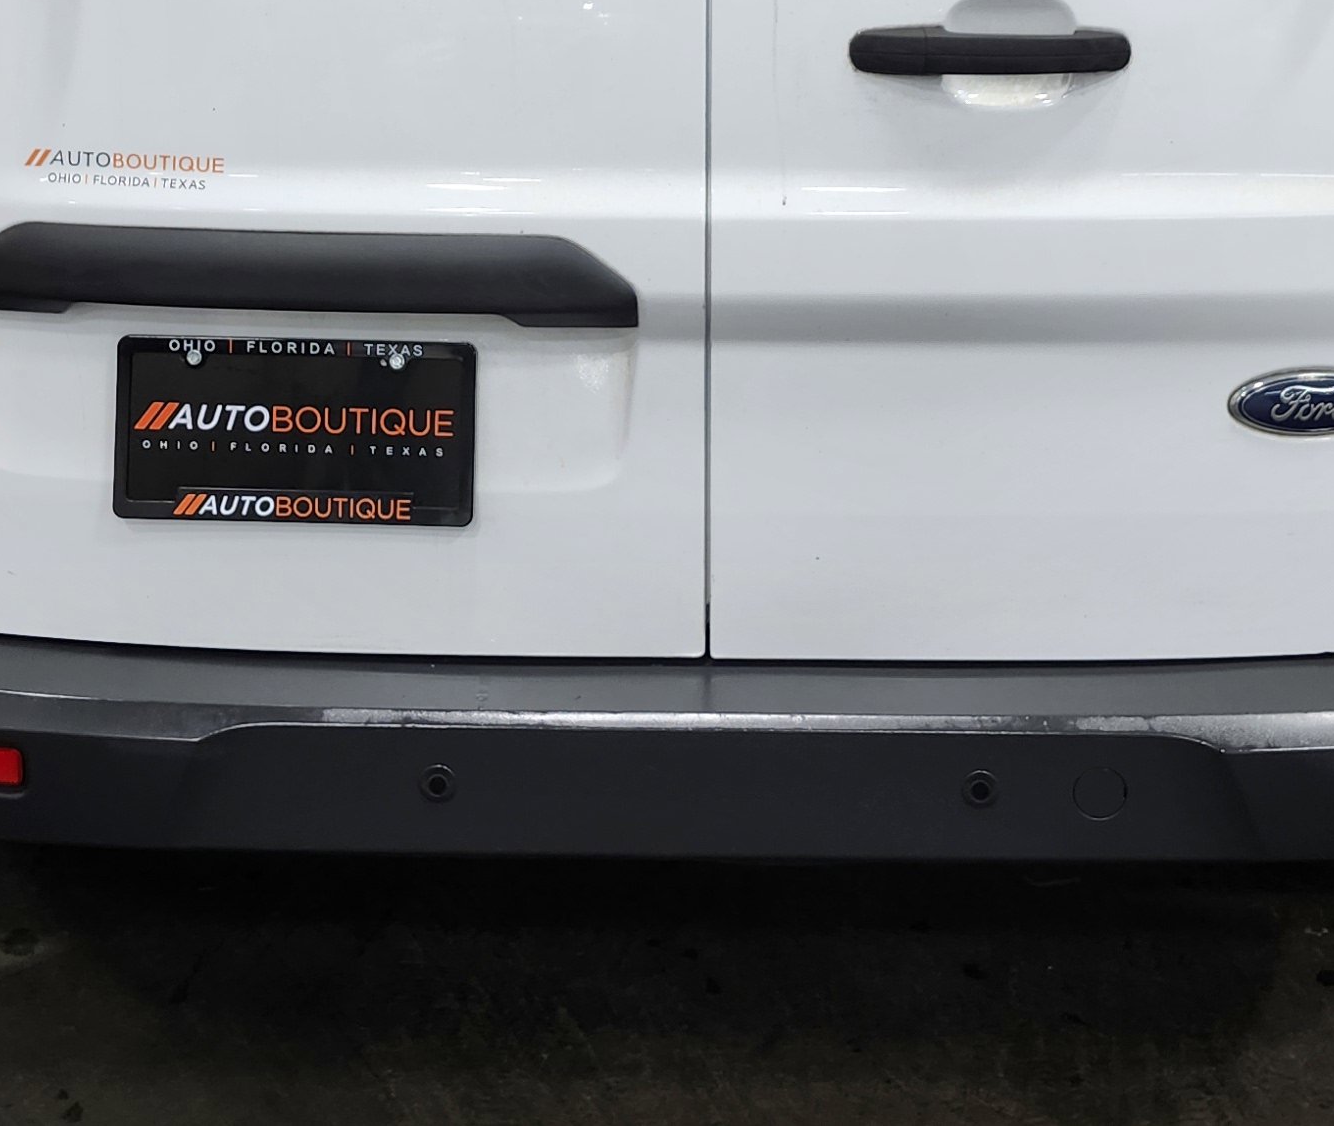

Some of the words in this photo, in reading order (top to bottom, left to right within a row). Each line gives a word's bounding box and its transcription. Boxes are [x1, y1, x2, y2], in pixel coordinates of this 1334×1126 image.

[49, 149, 225, 174] AUTOBOUTIQUE
[47, 172, 82, 184] OHIO
[93, 174, 150, 188] FLORIDA
[161, 177, 206, 191] TEXAS
[168, 339, 217, 353] OHIO
[246, 340, 336, 356] FLORIDA
[364, 343, 424, 357] TEXAS
[168, 402, 455, 437] AUTOBOUTIQUE
[142, 439, 200, 451] OHIO
[229, 442, 334, 454] FLORIDA
[369, 445, 444, 458] TEXAS
[198, 494, 412, 521] AUTOBOUTIQUE
